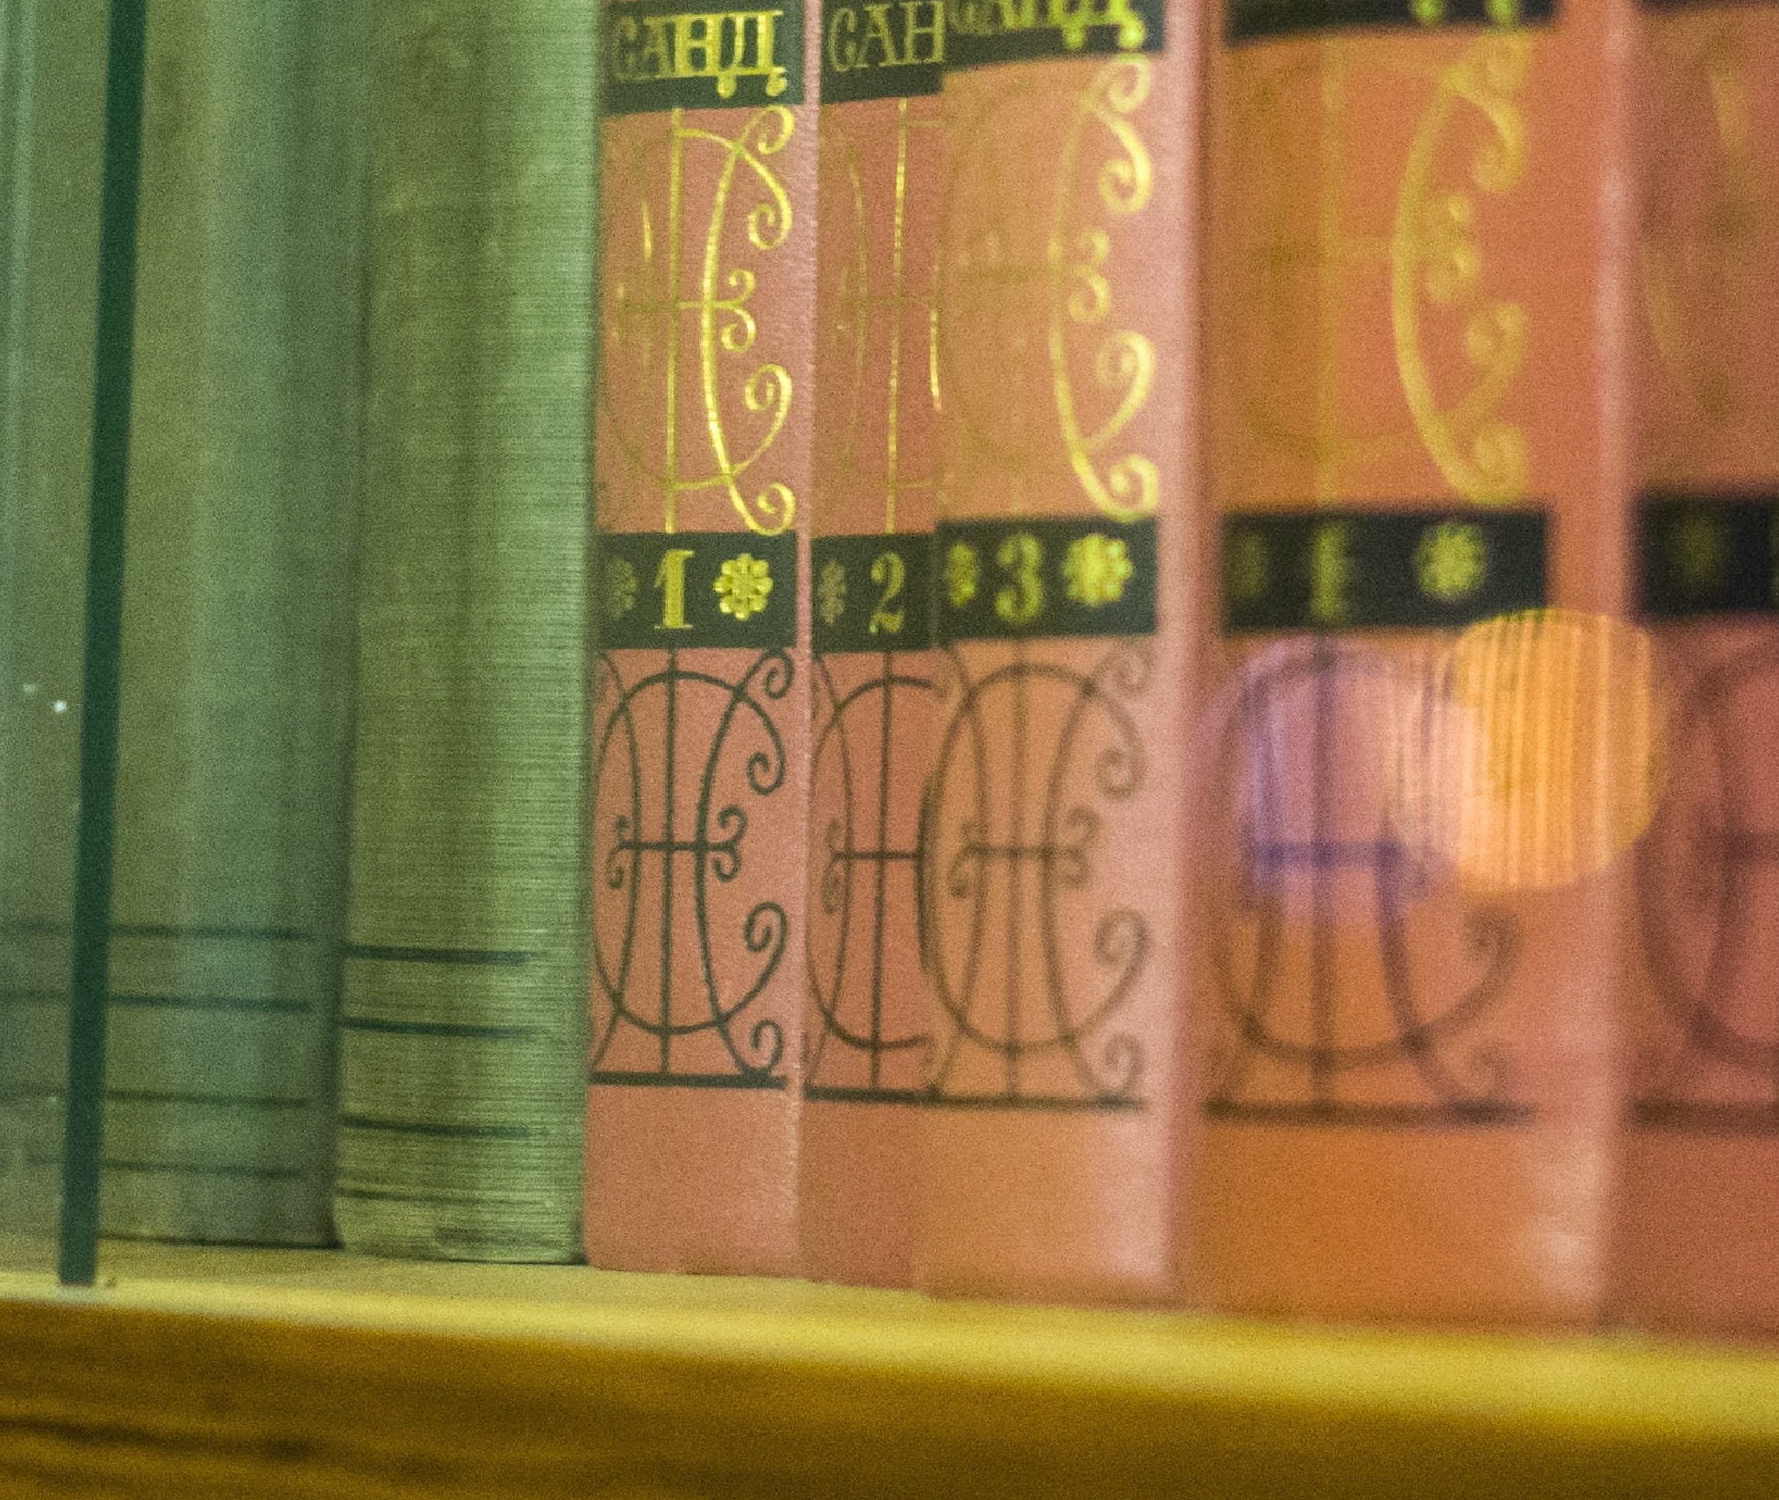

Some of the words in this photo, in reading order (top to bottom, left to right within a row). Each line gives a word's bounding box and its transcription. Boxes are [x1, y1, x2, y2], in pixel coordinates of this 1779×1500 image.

[654, 550, 694, 630] 1
[869, 552, 905, 633] 2
[995, 533, 1044, 624] 3
